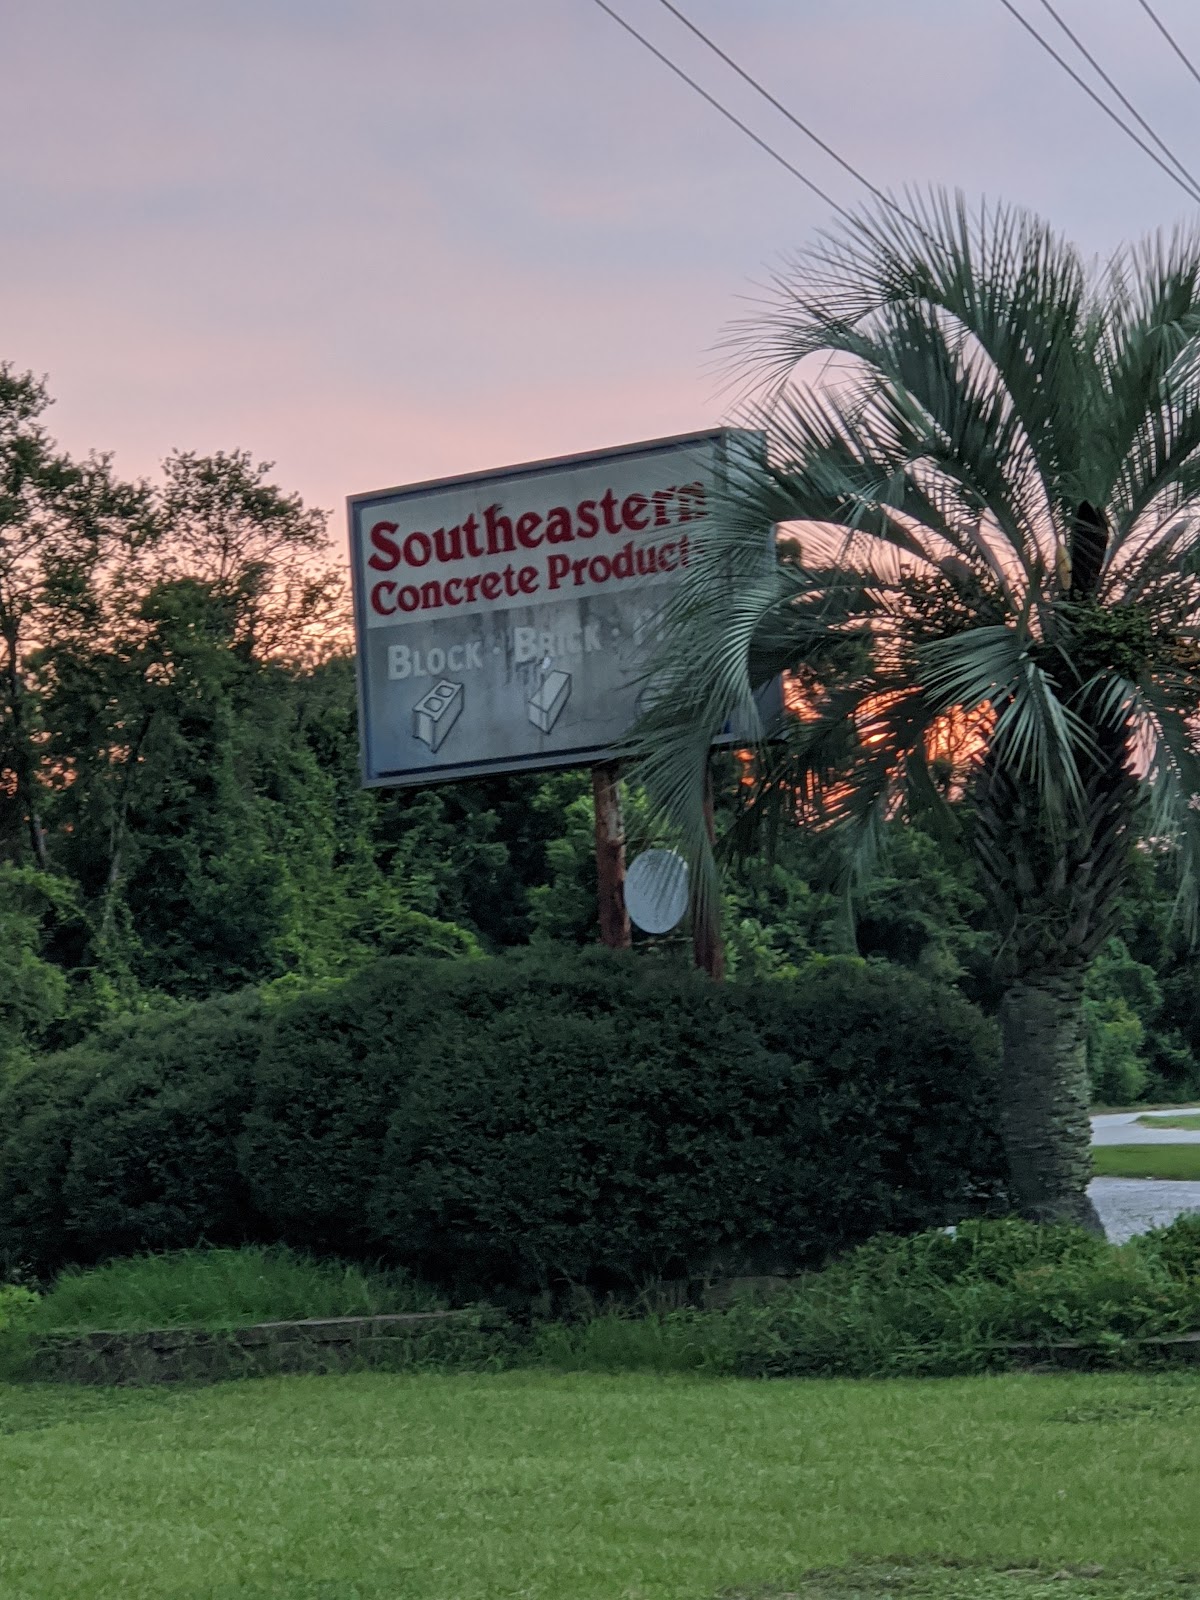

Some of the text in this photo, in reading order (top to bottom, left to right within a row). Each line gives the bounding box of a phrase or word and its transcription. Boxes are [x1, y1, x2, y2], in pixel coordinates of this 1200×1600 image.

[368, 481, 708, 571] Southeastern
[371, 534, 705, 616] Concrete Product
[388, 641, 483, 680] BLOCK
